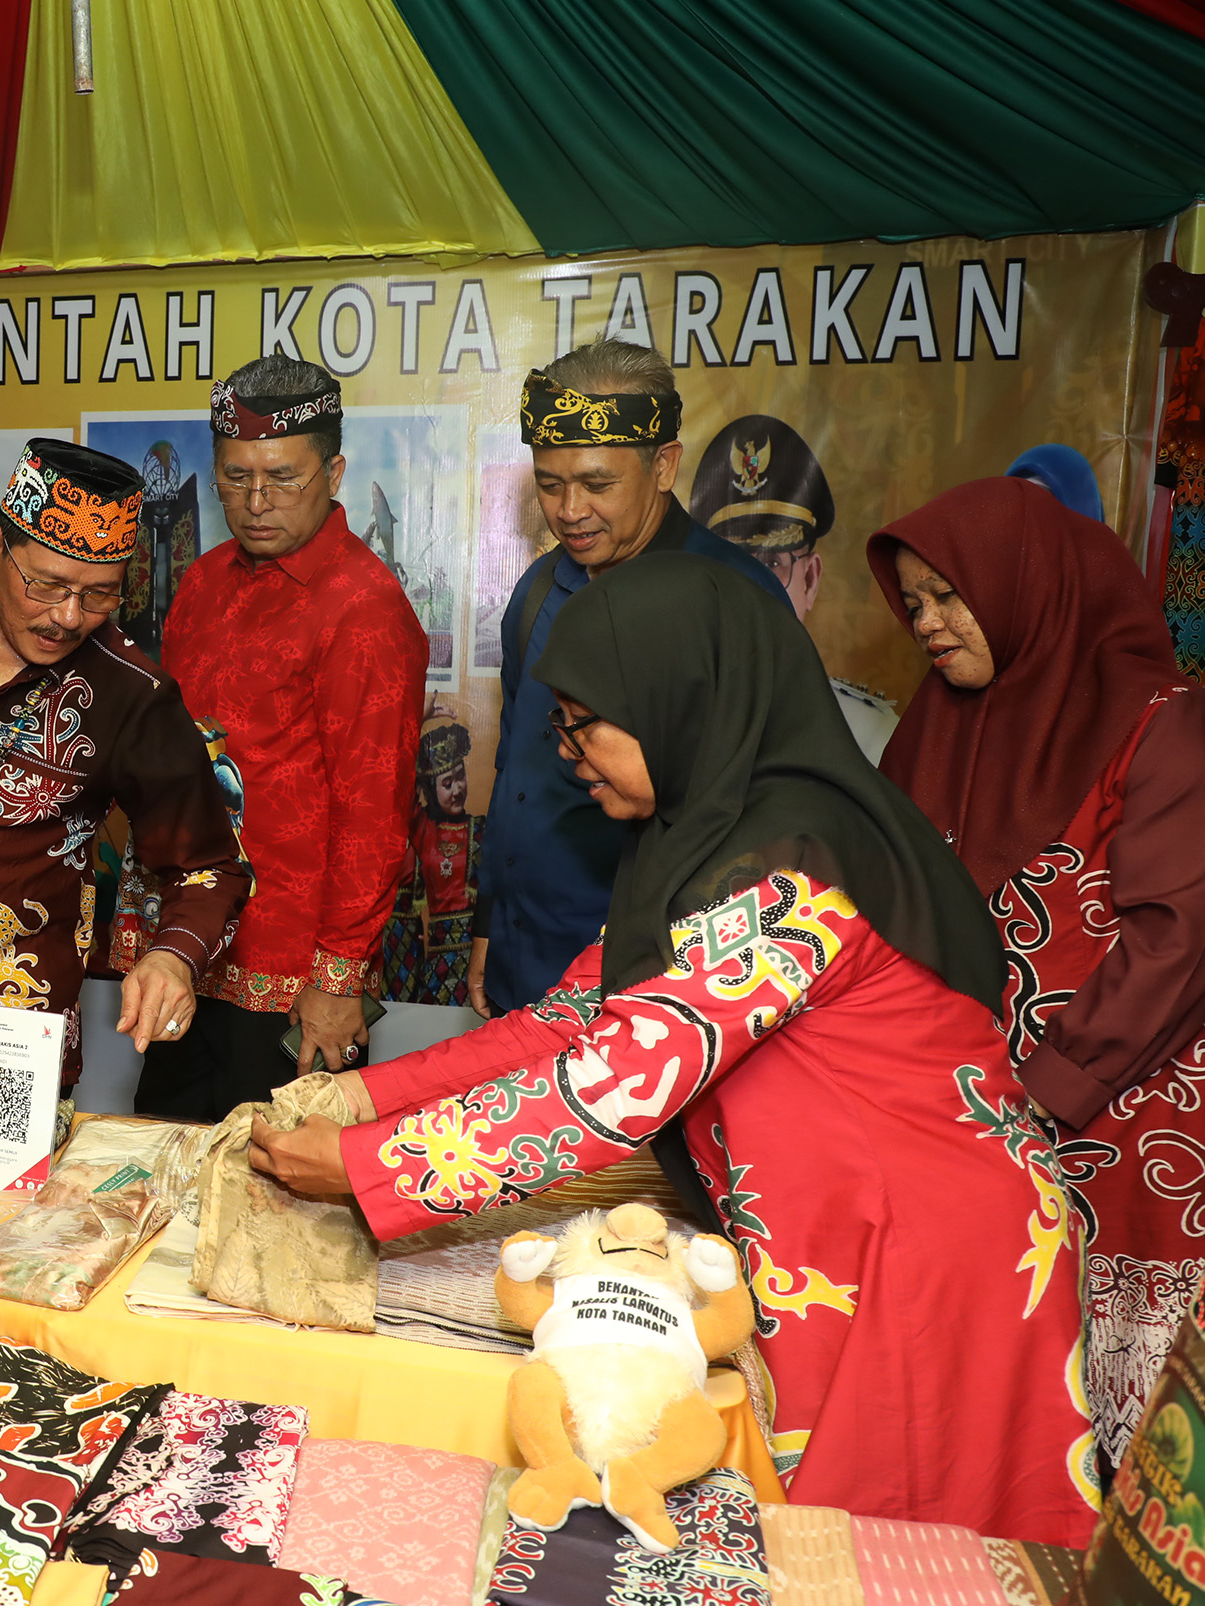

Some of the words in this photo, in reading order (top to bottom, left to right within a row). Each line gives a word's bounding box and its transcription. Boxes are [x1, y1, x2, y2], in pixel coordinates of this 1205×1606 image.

[260, 278, 500, 378] KOTA
[541, 258, 1026, 368] TARAKAN
[598, 1281, 659, 1299] BEKANT
[577, 1308, 607, 1319] KOTA
[612, 1310, 666, 1336] TARAKAN
